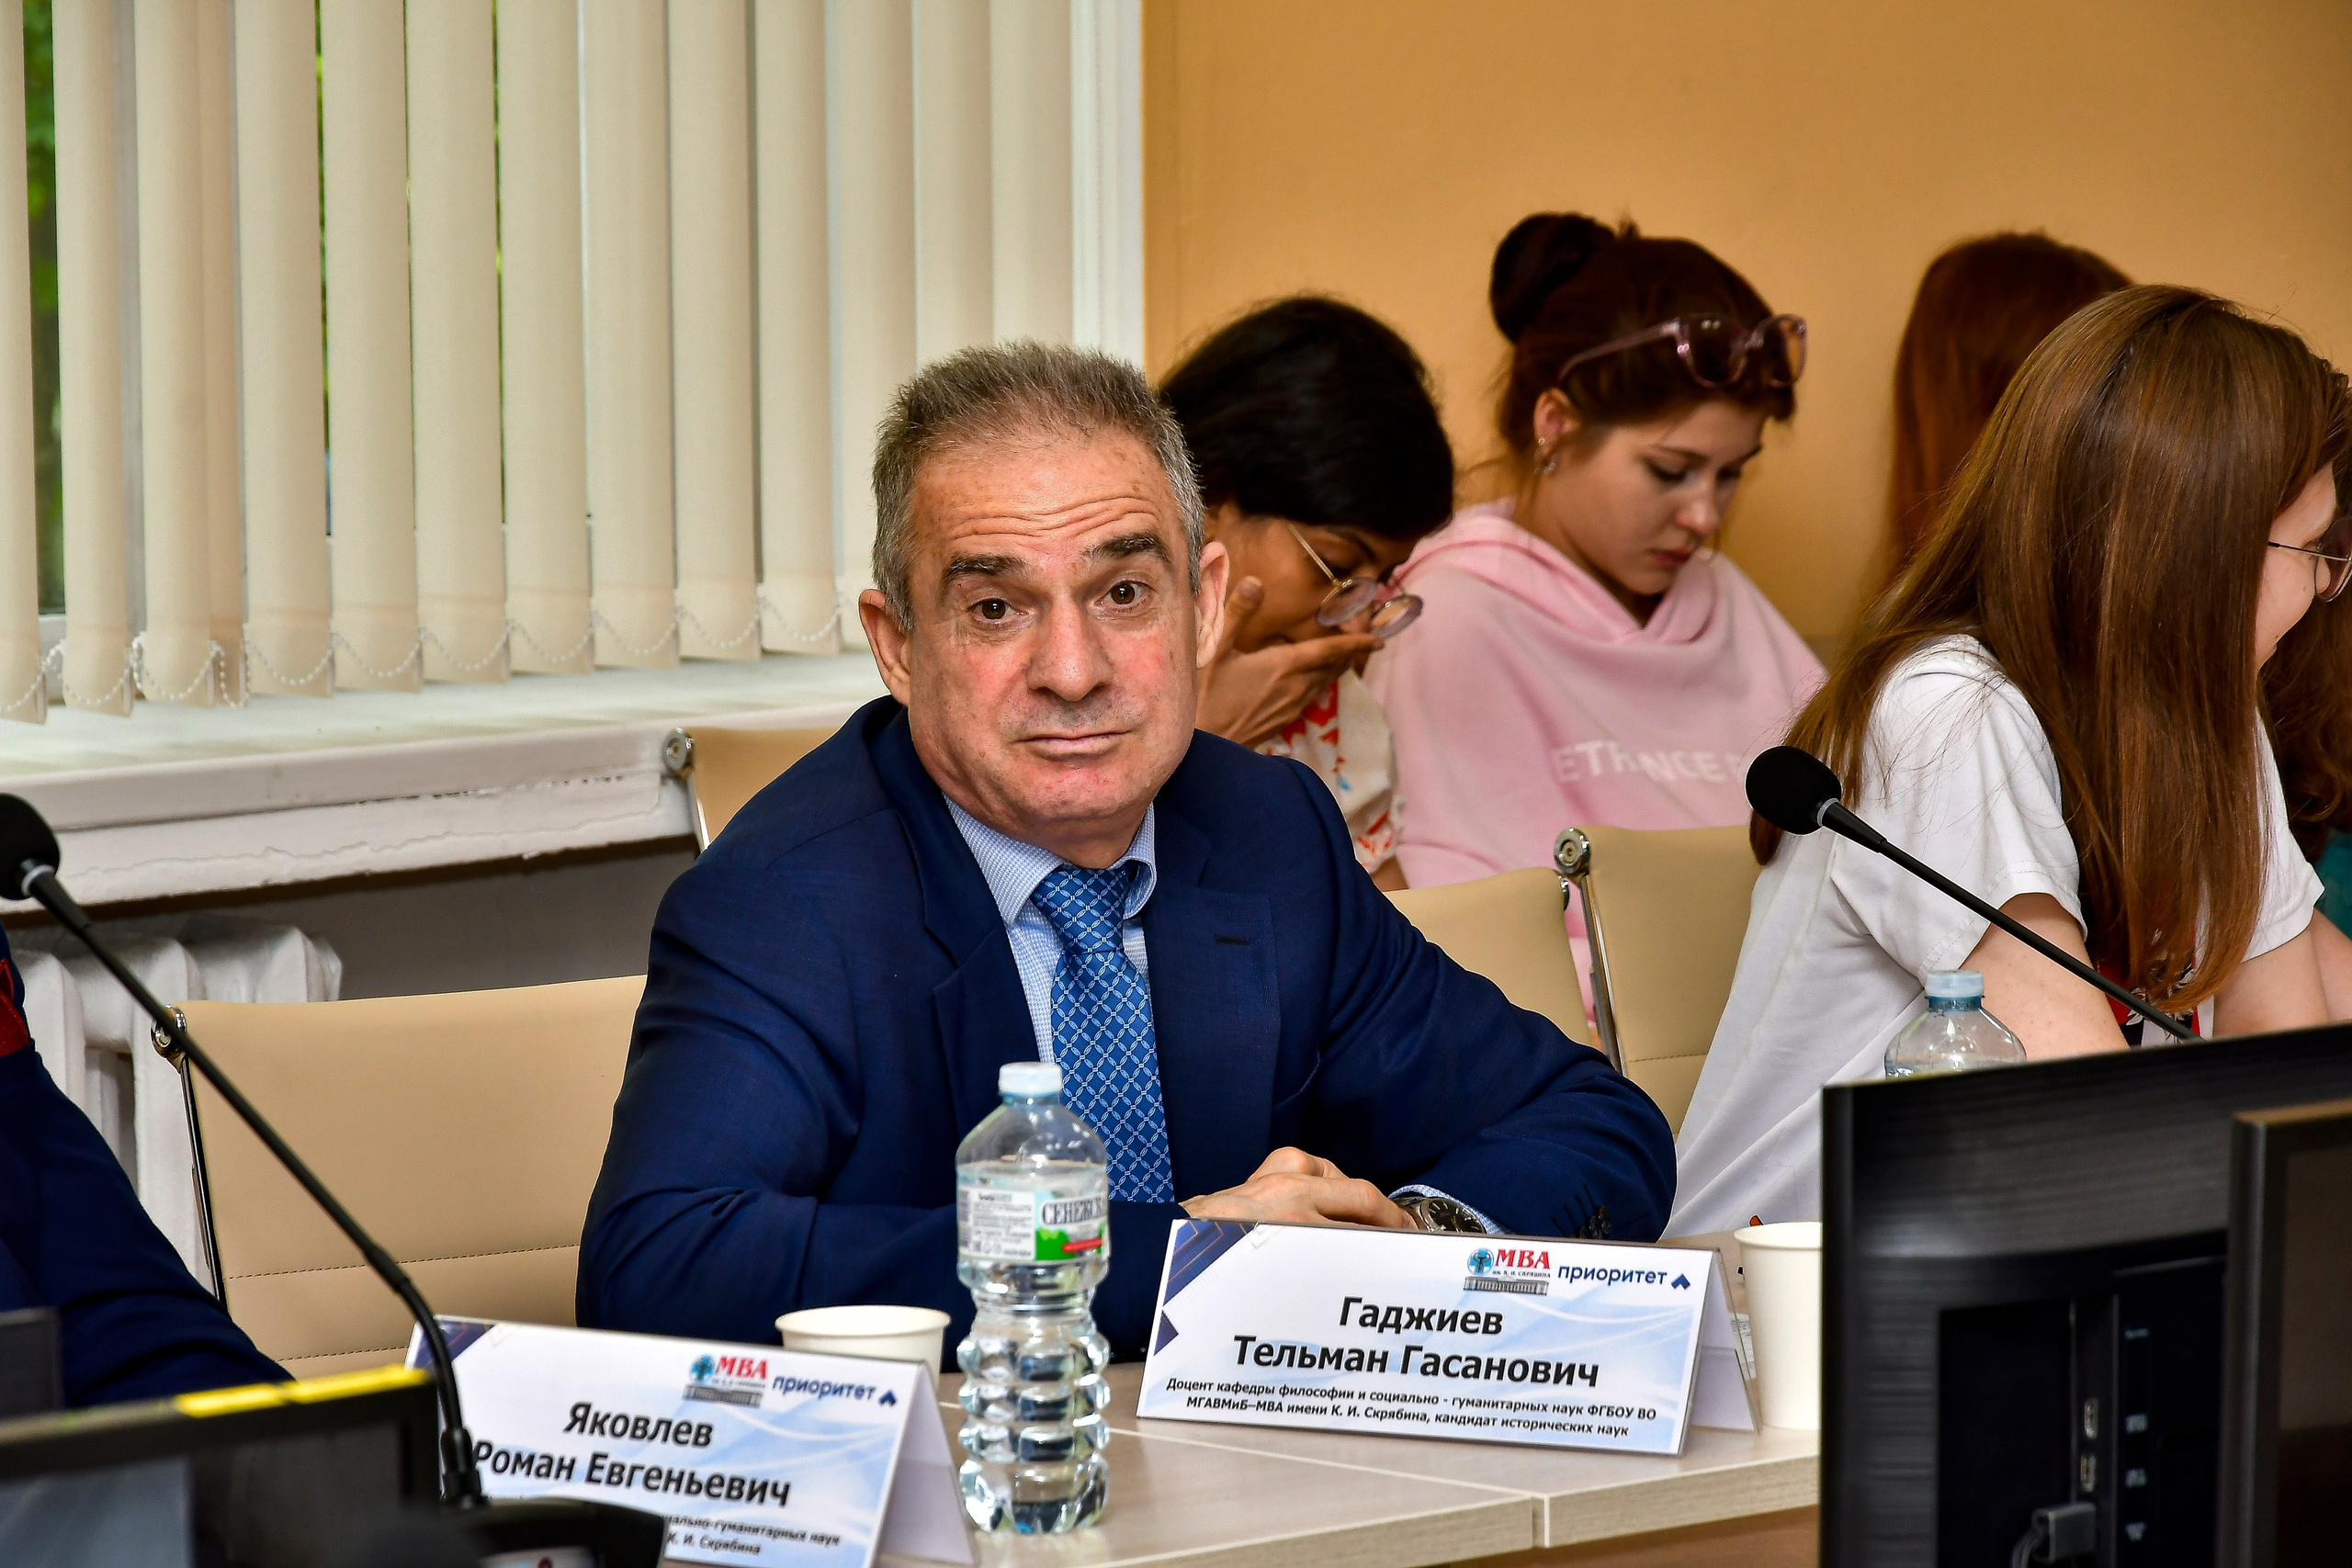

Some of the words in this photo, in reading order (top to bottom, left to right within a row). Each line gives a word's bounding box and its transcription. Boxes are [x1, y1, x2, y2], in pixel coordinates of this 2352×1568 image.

[1495, 1248, 1551, 1269] МВА
[1558, 1265, 1667, 1285] приоритет
[1339, 1296, 1504, 1335] Гаджиев
[715, 1356, 768, 1381] МВА
[1233, 1335, 1388, 1373] Тельман
[1400, 1345, 1600, 1388] Гасанович
[772, 1376, 876, 1401] приоритет
[1167, 1378, 1214, 1393] Доцент
[1216, 1381, 1274, 1396] кафедры
[1279, 1383, 1354, 1400] философии
[1358, 1391, 1366, 1400] и
[1370, 1392, 1439, 1405] социально
[1452, 1397, 1547, 1414] гуманитарных
[1552, 1404, 1583, 1416] наук
[1588, 1404, 1634, 1419] ФГБОУ
[1637, 1408, 1657, 1421] ВО
[562, 1402, 714, 1449] Яковлев
[1286, 1404, 1328, 1416] имени
[1331, 1404, 1342, 1416] К.
[1347, 1406, 1360, 1417] И.
[1364, 1407, 1430, 1425] Скрябина,
[1434, 1414, 1498, 1428] кандидат
[1500, 1417, 1593, 1434] исторических
[1597, 1426, 1629, 1438] наук
[473, 1440, 576, 1482] Роман
[584, 1451, 792, 1507] Евгеньевич
[700, 1535, 762, 1554] Скрябина
